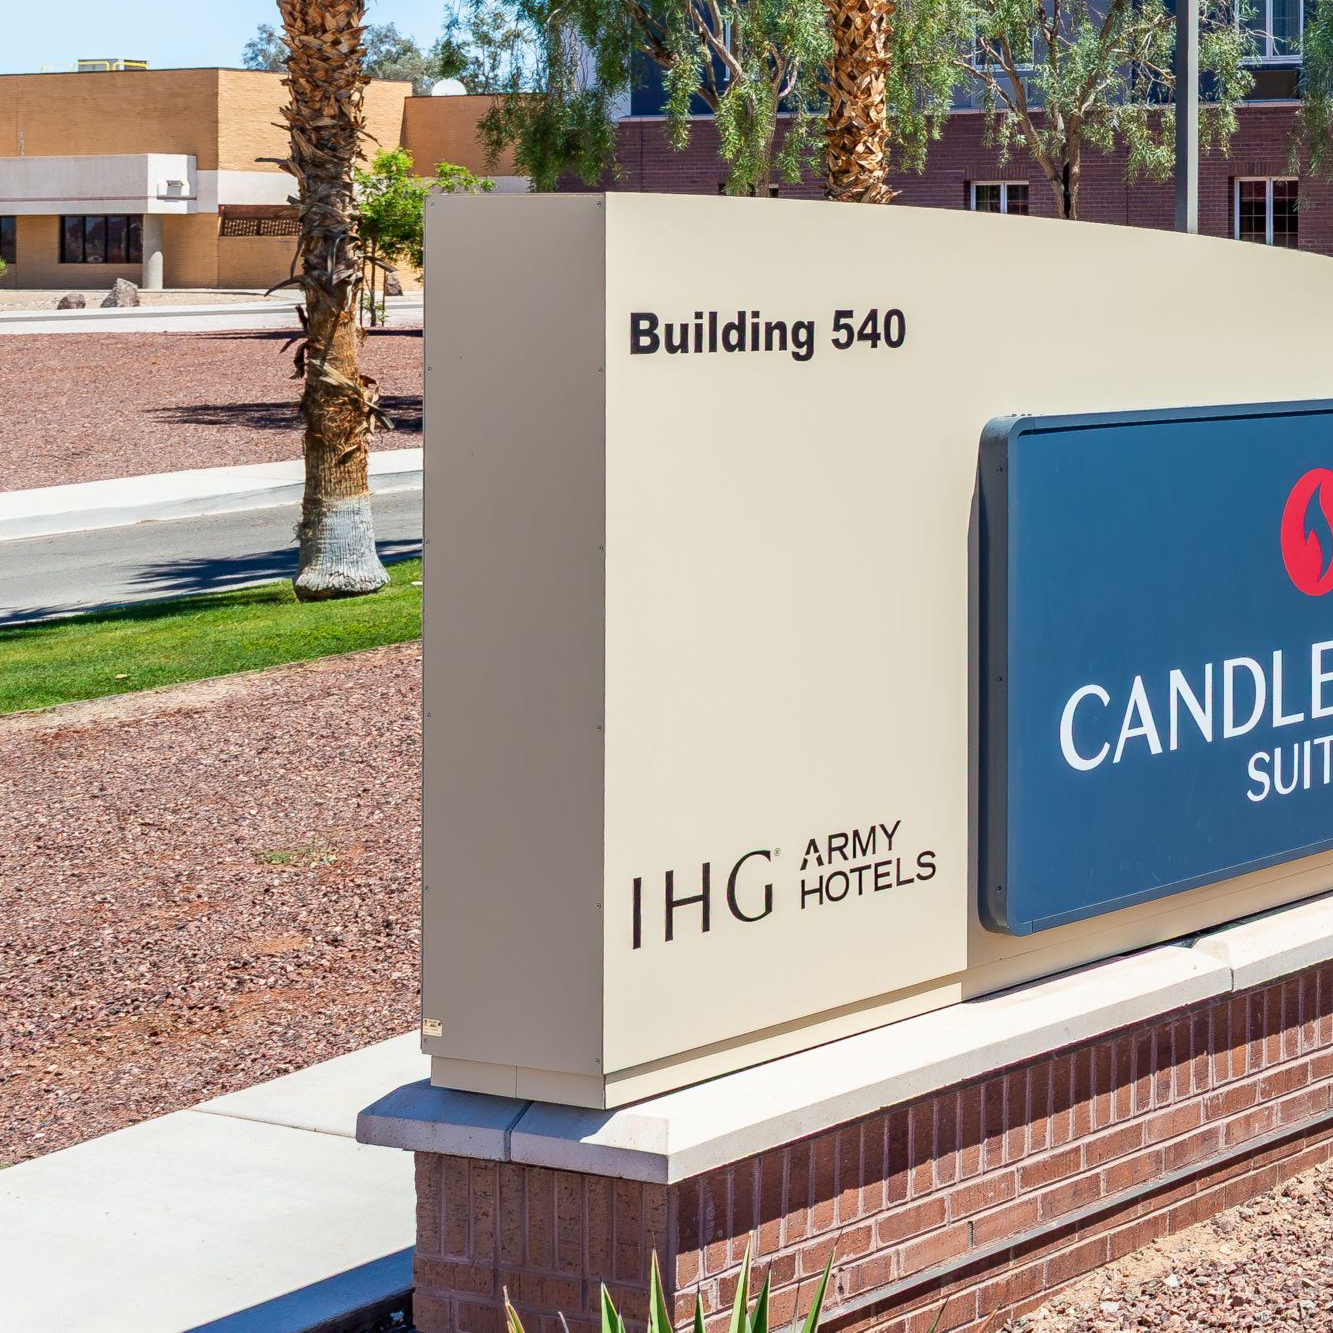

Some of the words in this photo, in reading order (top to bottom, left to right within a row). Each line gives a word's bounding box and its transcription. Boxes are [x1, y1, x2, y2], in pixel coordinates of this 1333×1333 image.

[629, 309, 816, 362] Building
[830, 308, 907, 351] 540
[799, 819, 902, 872] ARMY
[800, 849, 937, 910] HOTELS
